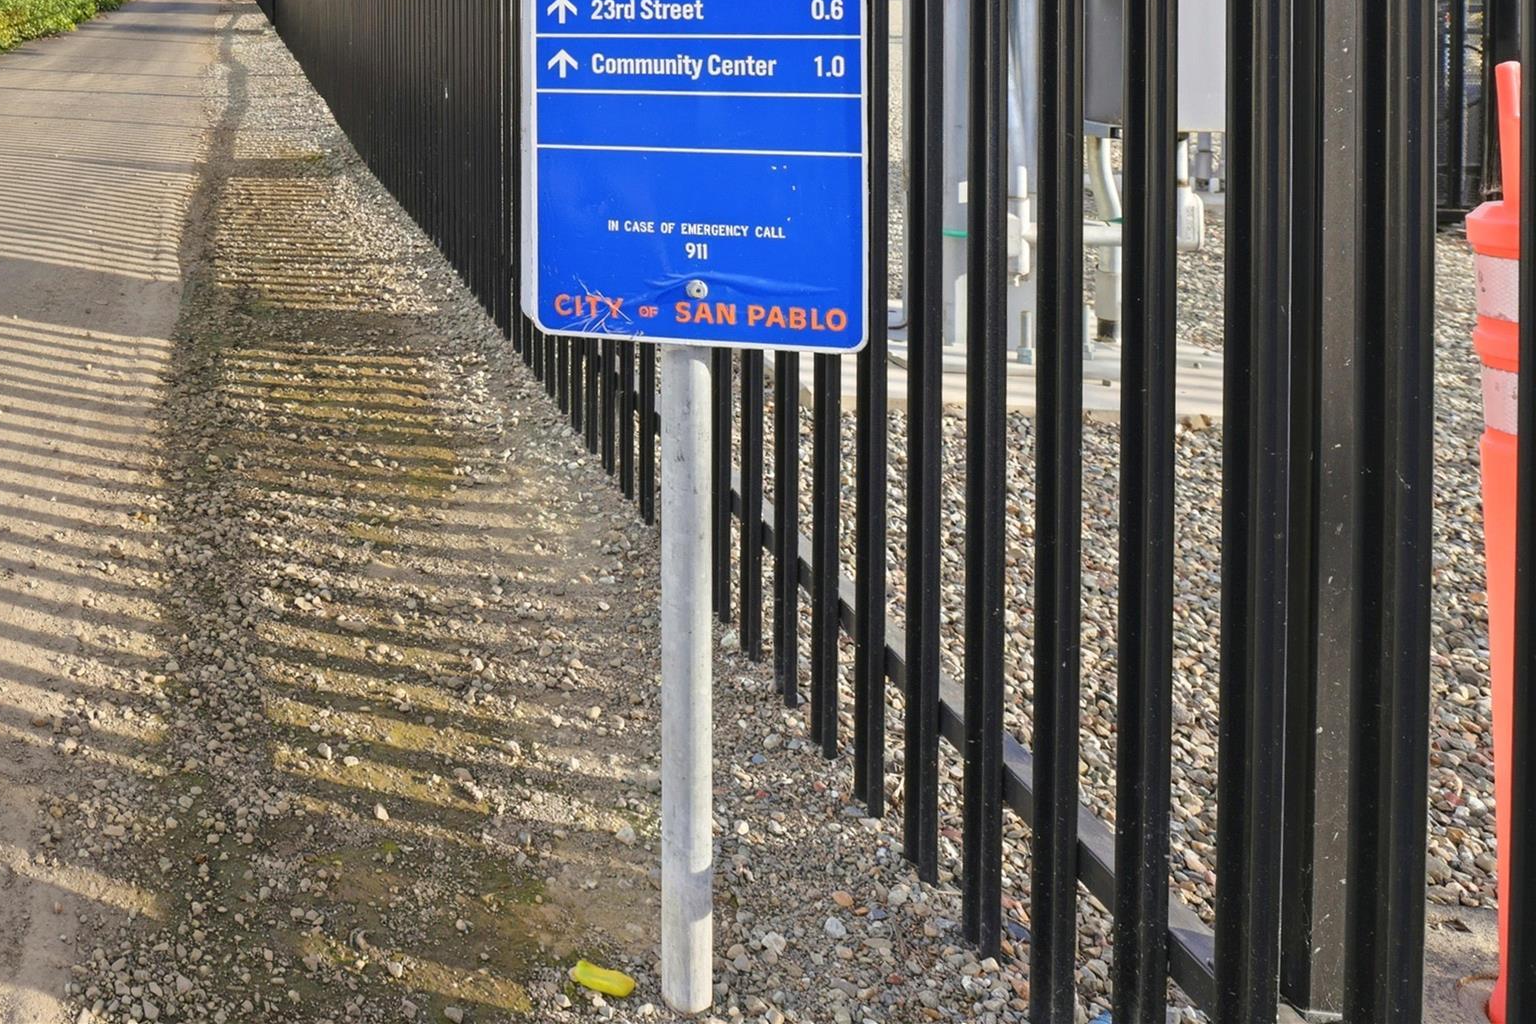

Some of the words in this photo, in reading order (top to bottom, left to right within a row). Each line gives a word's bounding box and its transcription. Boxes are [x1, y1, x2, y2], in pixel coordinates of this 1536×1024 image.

[590, 0, 636, 20] 23rd
[591, 53, 703, 80] Community
[707, 54, 777, 77] Center
[814, 55, 845, 78] 1.0
[607, 220, 619, 232] IN
[624, 221, 655, 233] CASE
[660, 222, 676, 234] OF
[680, 223, 749, 237] EMERGENCY
[755, 225, 786, 239] CALL
[685, 243, 709, 260] 911
[553, 293, 624, 319] CITY
[638, 305, 658, 318] OF
[675, 301, 736, 326] SAN
[748, 303, 848, 332] PABLO
